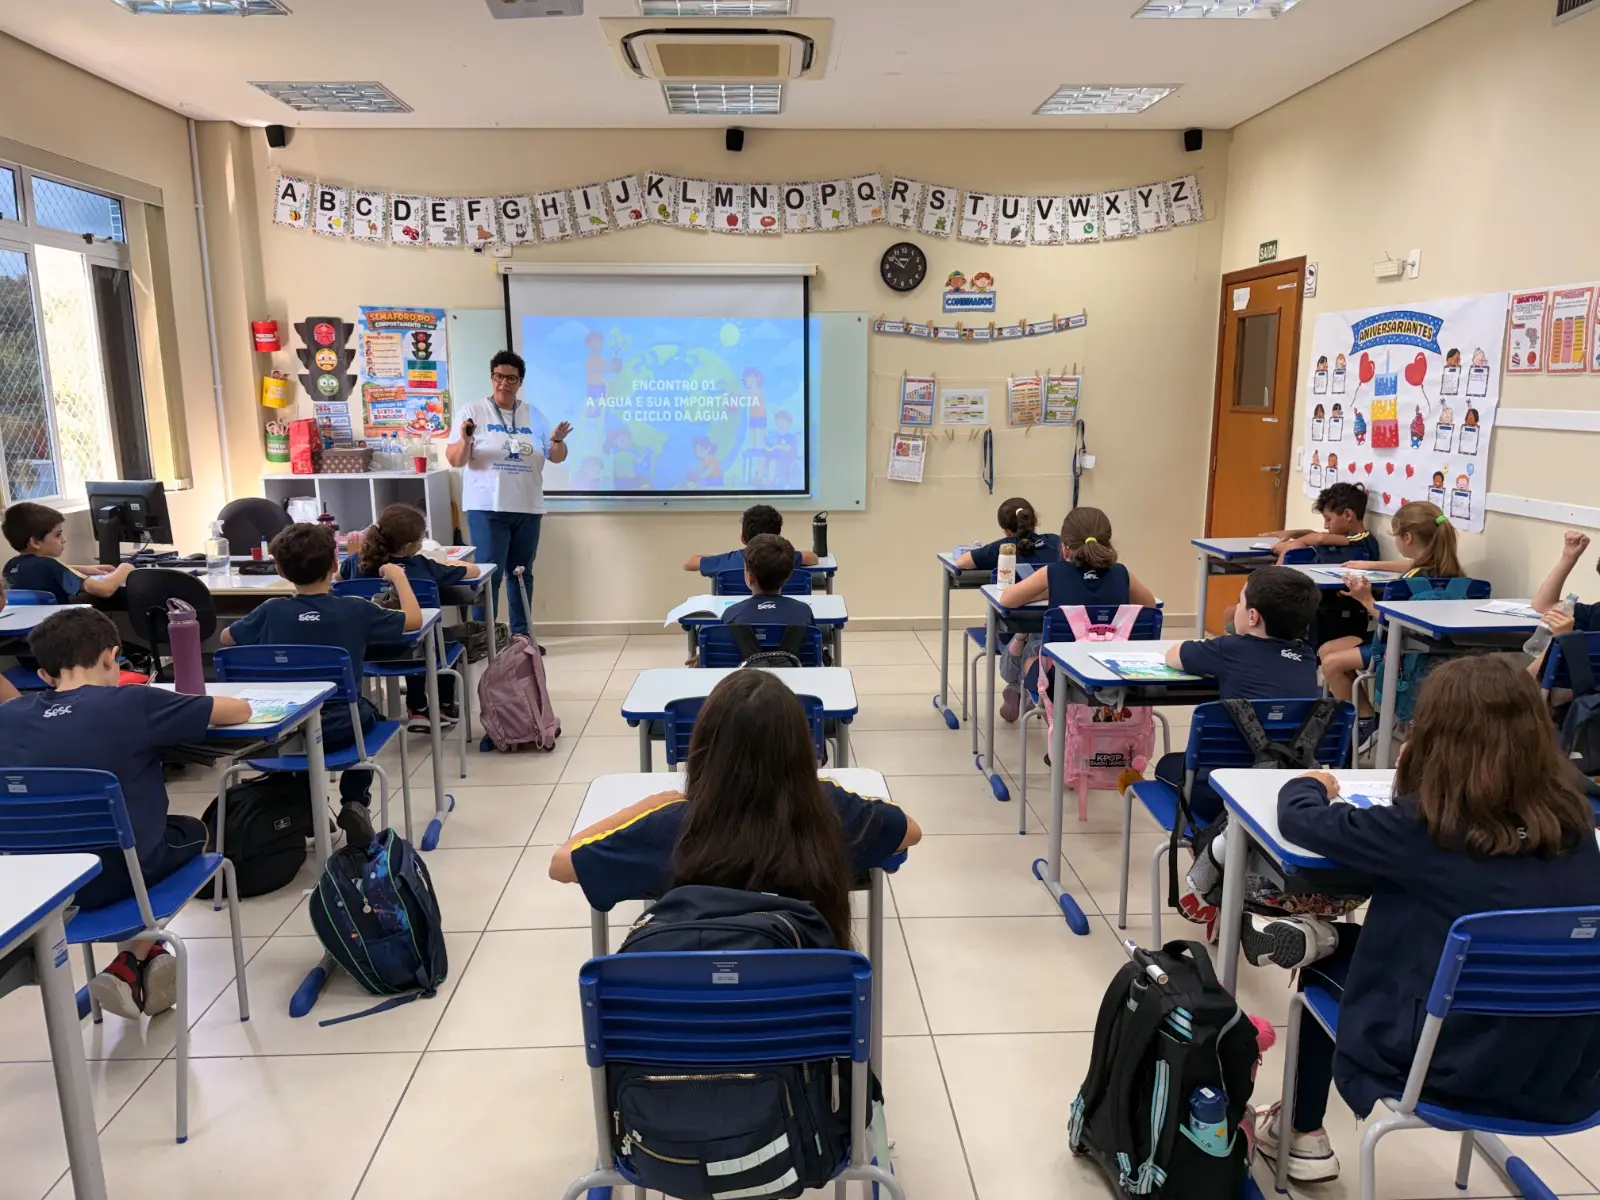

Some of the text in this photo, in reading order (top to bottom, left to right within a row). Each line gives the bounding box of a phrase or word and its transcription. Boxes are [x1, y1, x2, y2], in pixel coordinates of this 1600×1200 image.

[281, 183, 297, 202] A
[320, 191, 336, 211] B
[356, 198, 372, 216] C
[394, 200, 411, 220] D
[432, 203, 447, 222] E
[468, 201, 481, 221] F
[502, 200, 520, 219] G
[541, 197, 558, 217] H
[583, 190, 590, 210] I
[616, 181, 629, 203] J
[647, 176, 664, 198] K
[682, 182, 696, 203] L
[715, 187, 733, 207] M
[750, 187, 767, 208] N
[785, 188, 804, 209] O
[821, 184, 836, 205] P
[858, 182, 876, 201] Q
[891, 181, 909, 203] R
[930, 190, 945, 210] S
[969, 195, 984, 215] T
[1002, 199, 1019, 219] U
[1037, 199, 1053, 220] V
[1069, 198, 1090, 217] W
[1105, 195, 1120, 215] X
[1138, 188, 1152, 208] Y
[1171, 181, 1188, 202] Z
[1260, 243, 1276, 260] SAÍDA
[417, 314, 430, 322] DO
[1359, 320, 1433, 342] ANIVERSARIANTES
[632, 380, 716, 391] ENCONTRO 01
[586, 393, 760, 408] A ÁGUA E SUA IMPORTÂNCIA
[623, 407, 729, 422] O CICLO DA ÁGUA
